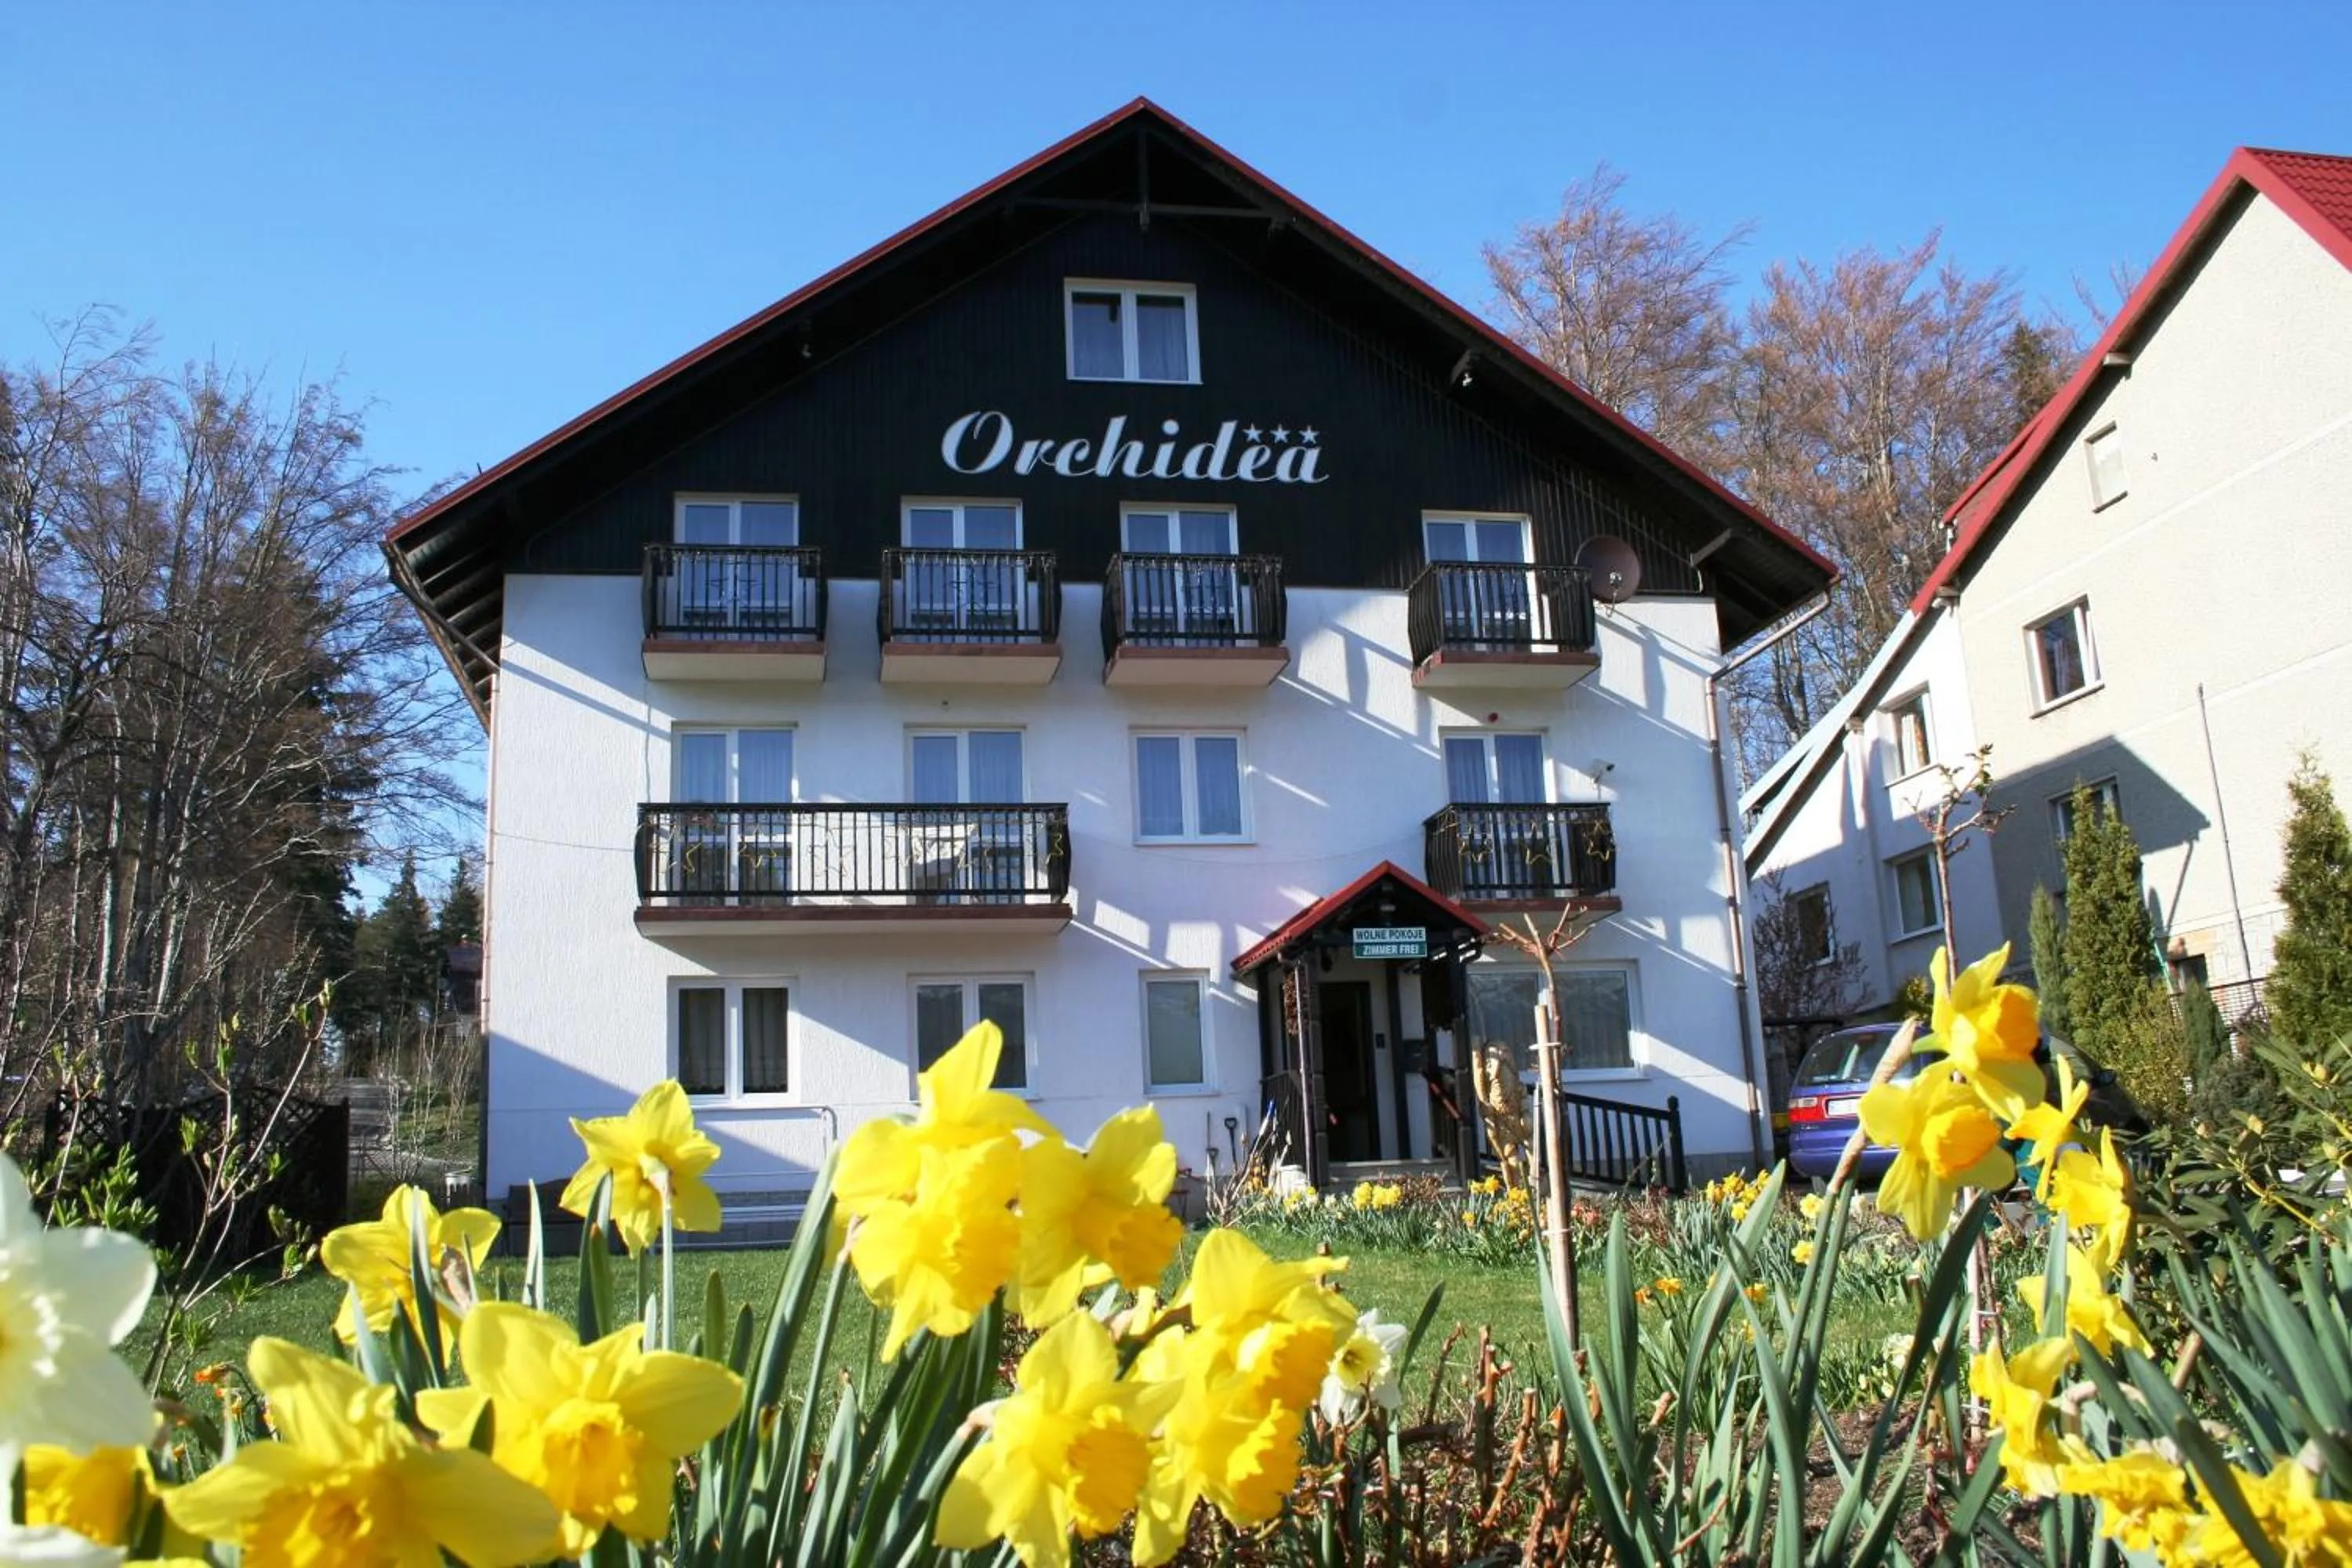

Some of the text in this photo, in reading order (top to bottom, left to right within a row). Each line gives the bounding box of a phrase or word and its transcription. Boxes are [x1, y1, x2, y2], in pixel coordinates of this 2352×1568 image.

[941, 411, 1330, 484] Orchidea
[1356, 929, 1423, 940] WOLNE POKOJE
[1363, 944, 1420, 955] ZIMMER FREI
